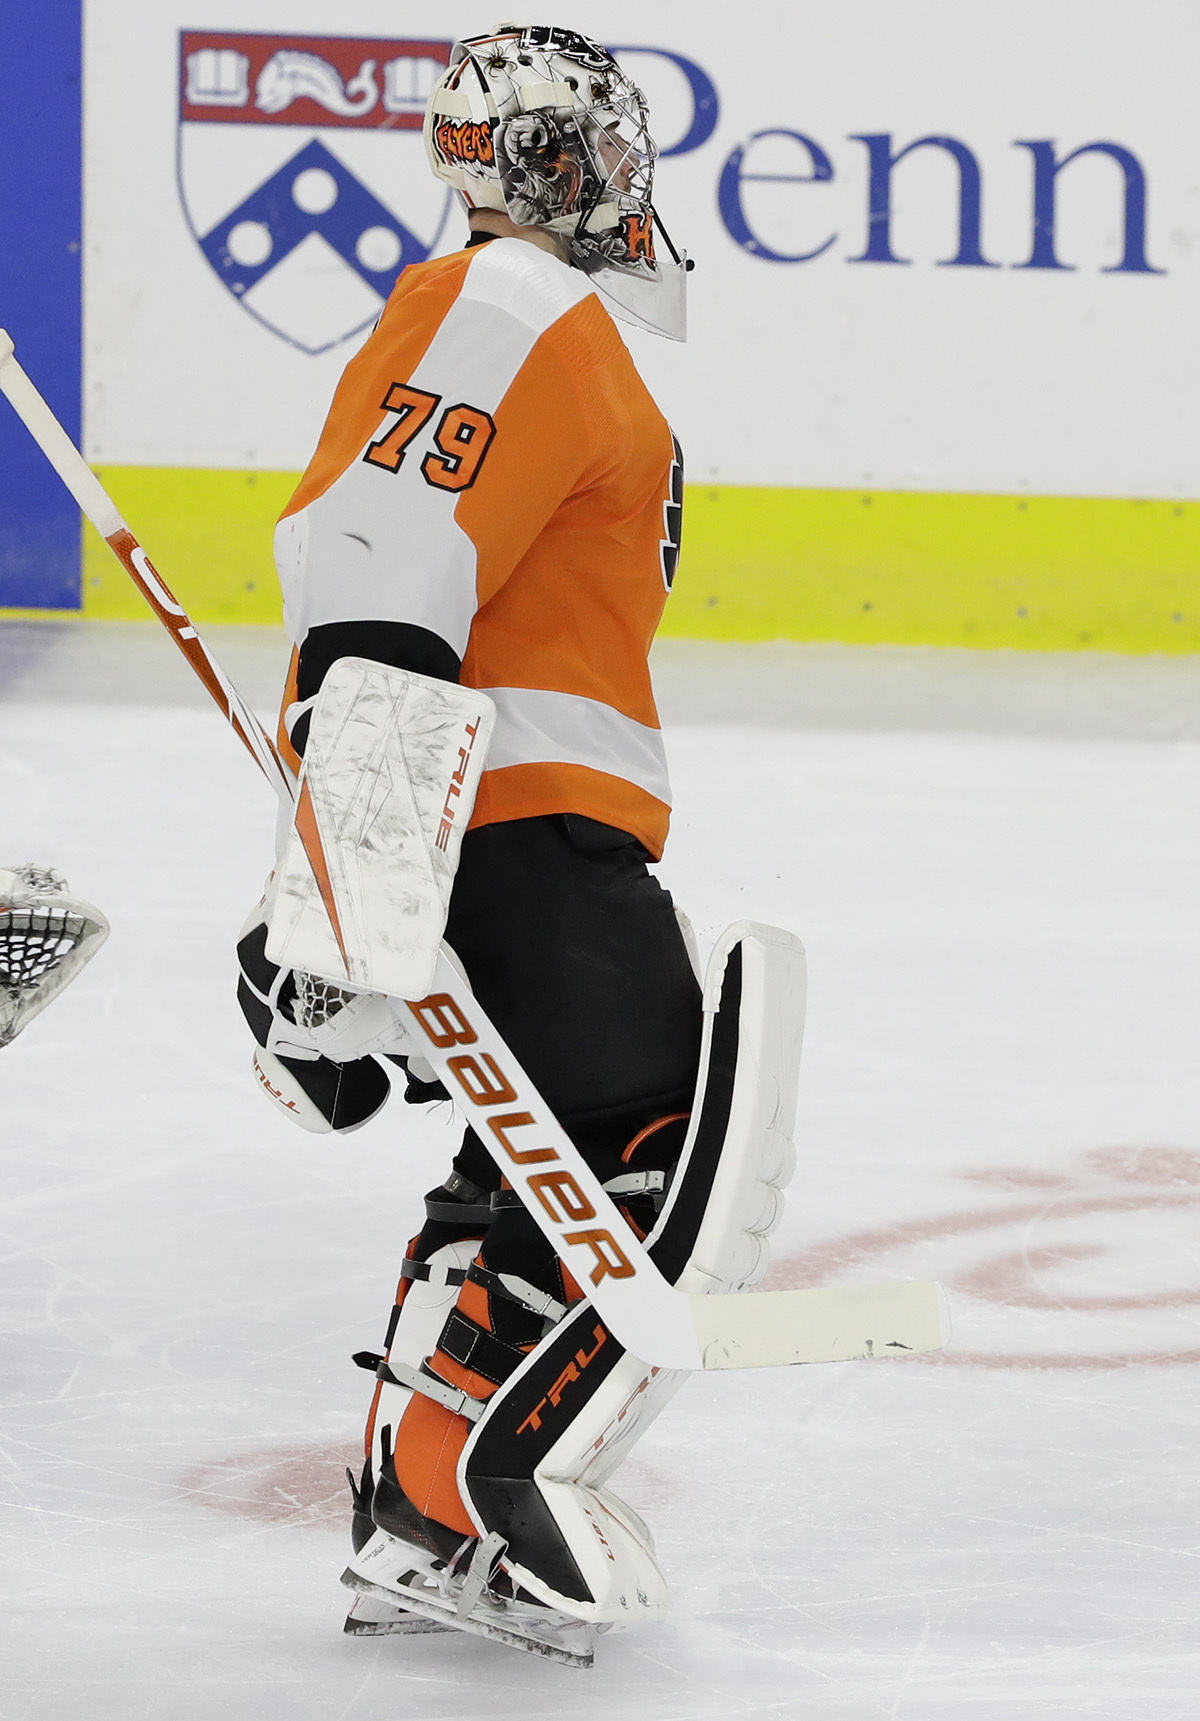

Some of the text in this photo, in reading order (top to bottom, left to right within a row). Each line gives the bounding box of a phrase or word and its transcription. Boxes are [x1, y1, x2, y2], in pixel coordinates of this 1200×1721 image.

[436, 121, 493, 163] FLYERS
[362, 381, 498, 494] 79
[434, 715, 481, 853] TRUE
[515, 1323, 608, 1435] TRU
